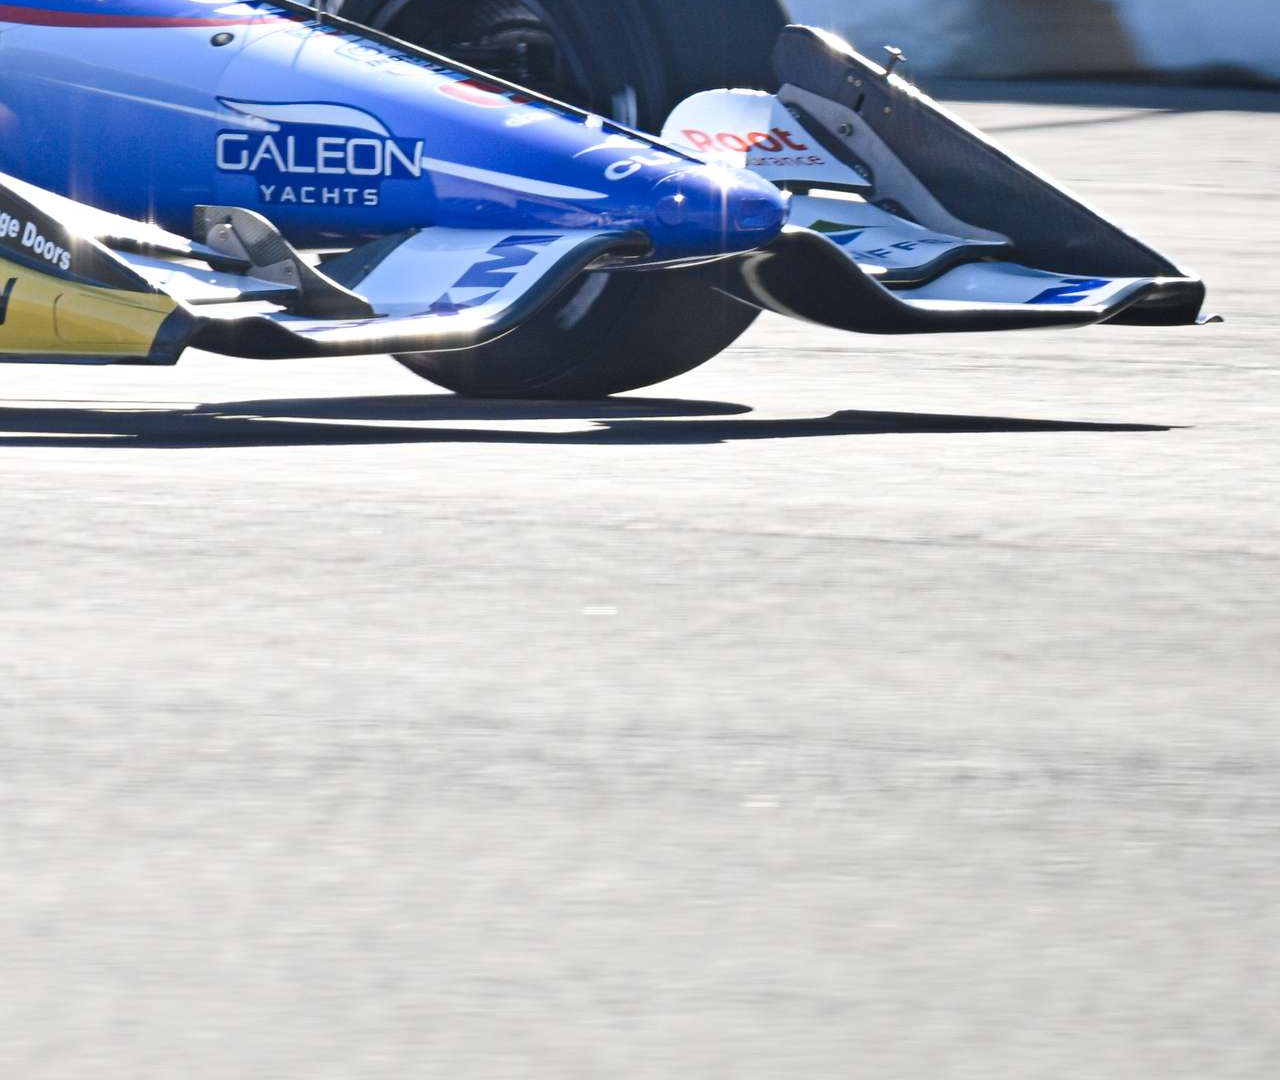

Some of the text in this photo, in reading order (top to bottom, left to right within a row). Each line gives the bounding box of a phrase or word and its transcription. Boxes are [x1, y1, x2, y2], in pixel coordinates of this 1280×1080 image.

[216, 132, 424, 178] GALEON
[680, 126, 808, 153] Root
[260, 184, 380, 207] YACHTS
[21, 222, 72, 270] Doors
